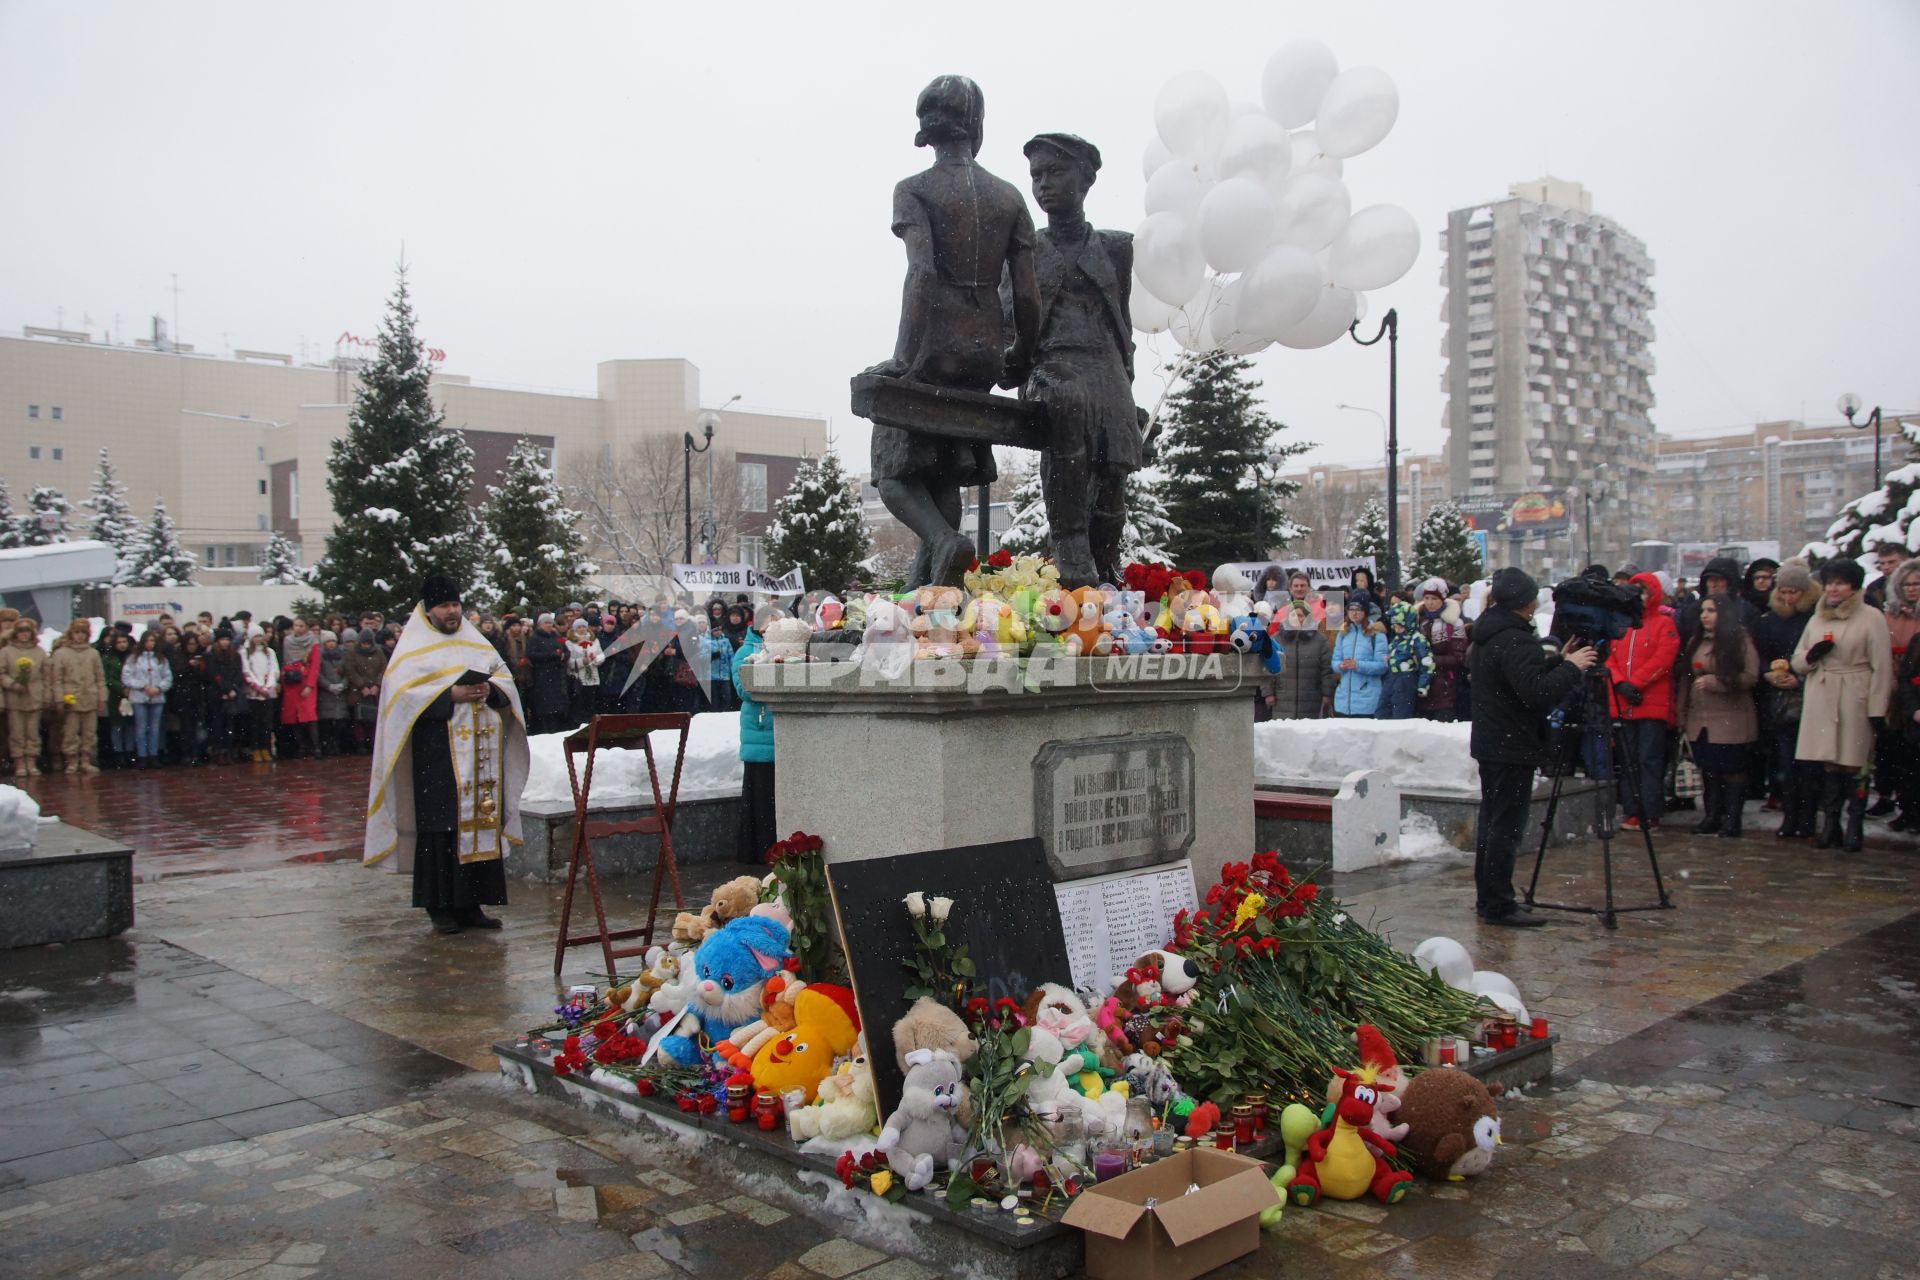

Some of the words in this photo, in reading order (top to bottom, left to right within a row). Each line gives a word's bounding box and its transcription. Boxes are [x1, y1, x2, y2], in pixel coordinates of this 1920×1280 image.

[684, 570, 740, 585] 25.03.2018
[1306, 567, 1325, 580] МЫ
[1327, 567, 1335, 580] С
[1064, 799, 1088, 824] ВОЙНА
[1104, 796, 1114, 819] НЕ
